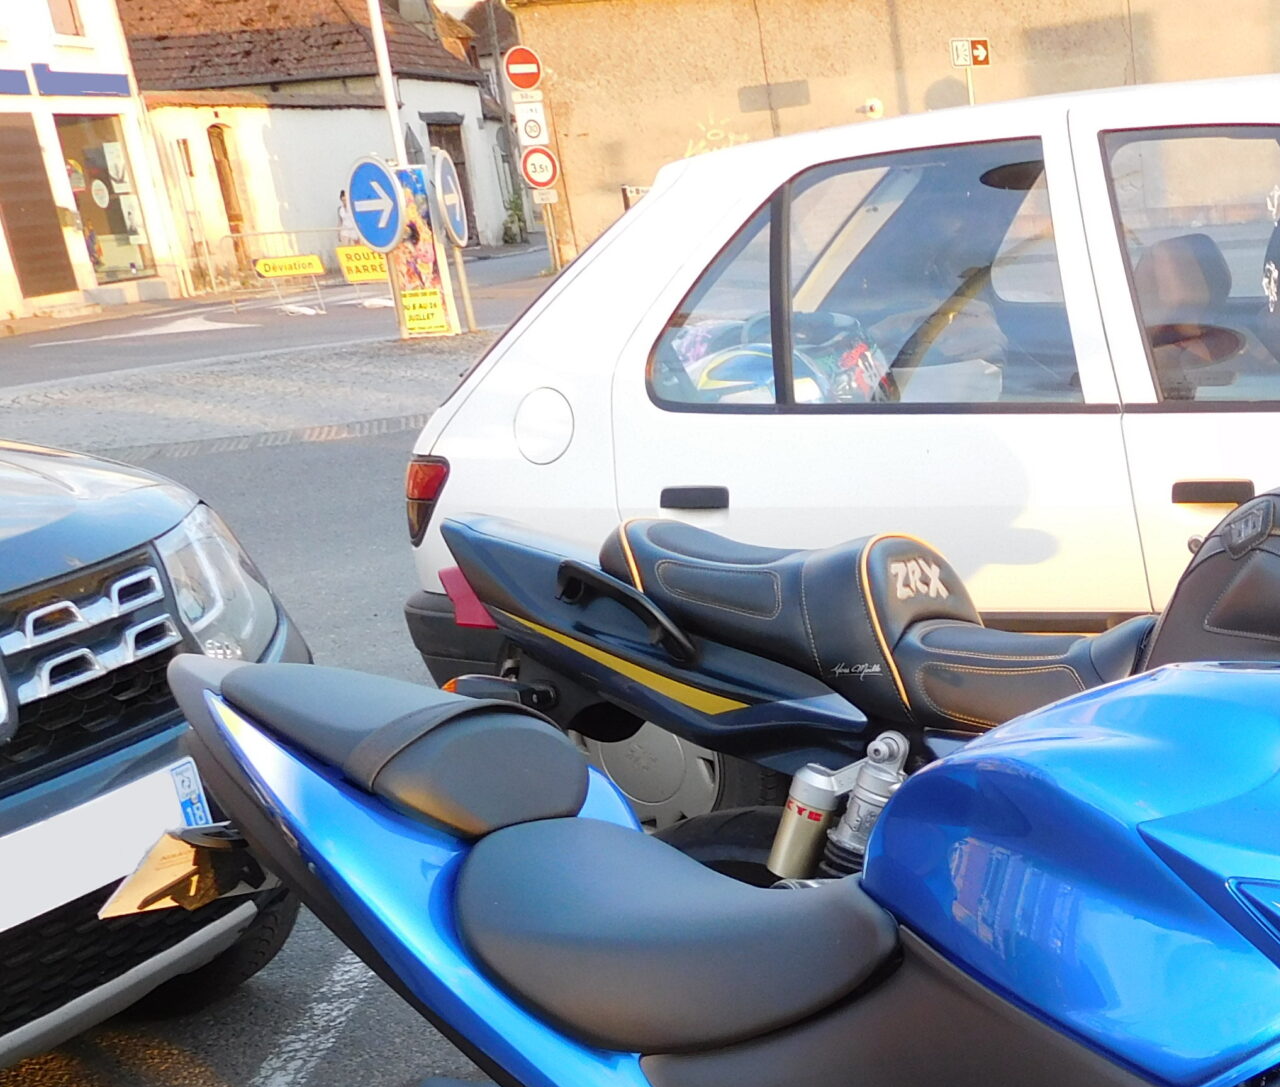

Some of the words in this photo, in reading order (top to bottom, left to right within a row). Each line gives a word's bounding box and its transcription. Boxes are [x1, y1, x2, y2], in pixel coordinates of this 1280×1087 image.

[345, 251, 384, 262] ROUTE
[263, 260, 314, 274] Déviation
[408, 312, 435, 322] JUILLET
[890, 556, 950, 600] ZRX
